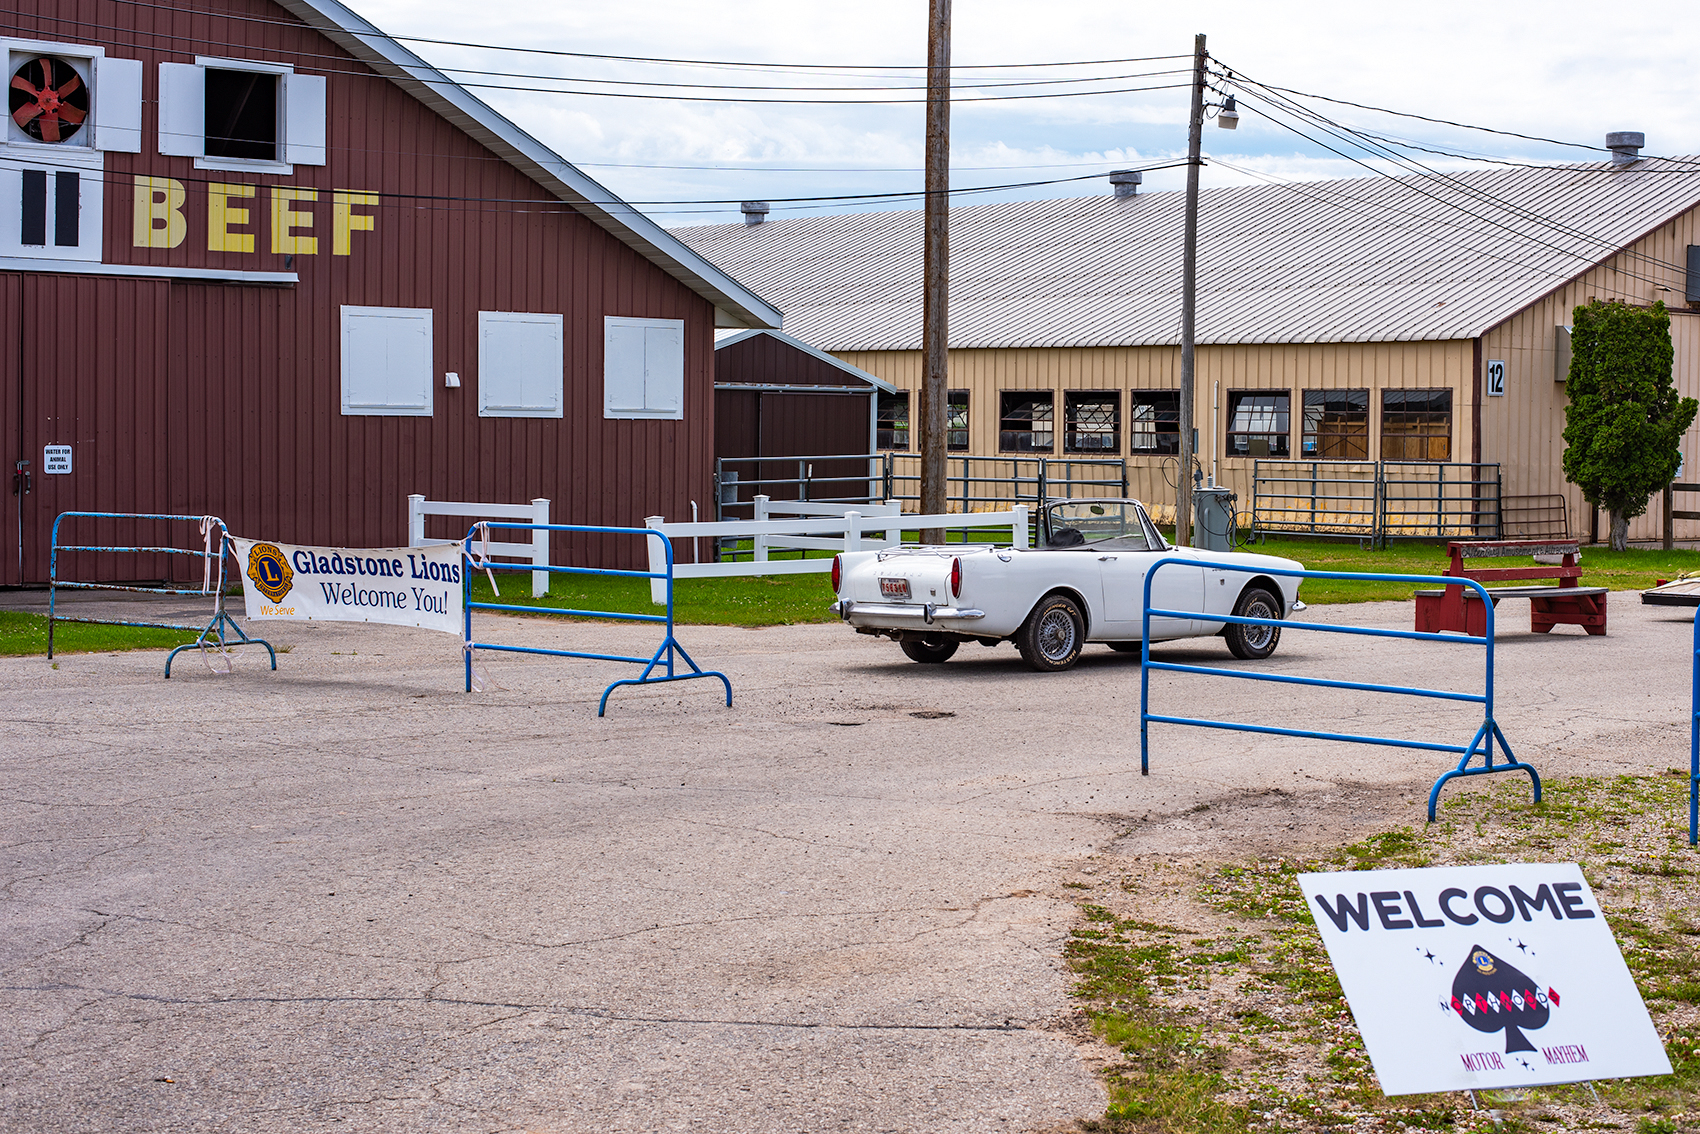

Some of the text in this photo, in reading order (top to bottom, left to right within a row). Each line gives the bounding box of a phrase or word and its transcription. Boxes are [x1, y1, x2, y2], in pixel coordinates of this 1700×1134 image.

[133, 175, 380, 256] BEEF
[1489, 364, 1503, 393] 12
[253, 545, 278, 556] LIONS
[261, 561, 280, 582] L
[292, 550, 461, 584] Gladstone Lions
[260, 604, 295, 616] We Serve
[320, 582, 448, 615] Welcome You!
[1315, 882, 1596, 933] WELCOME
[1440, 991, 1556, 1012] NORTHWOODS
[1460, 1044, 1590, 1072] MOTOR MAYHEM
